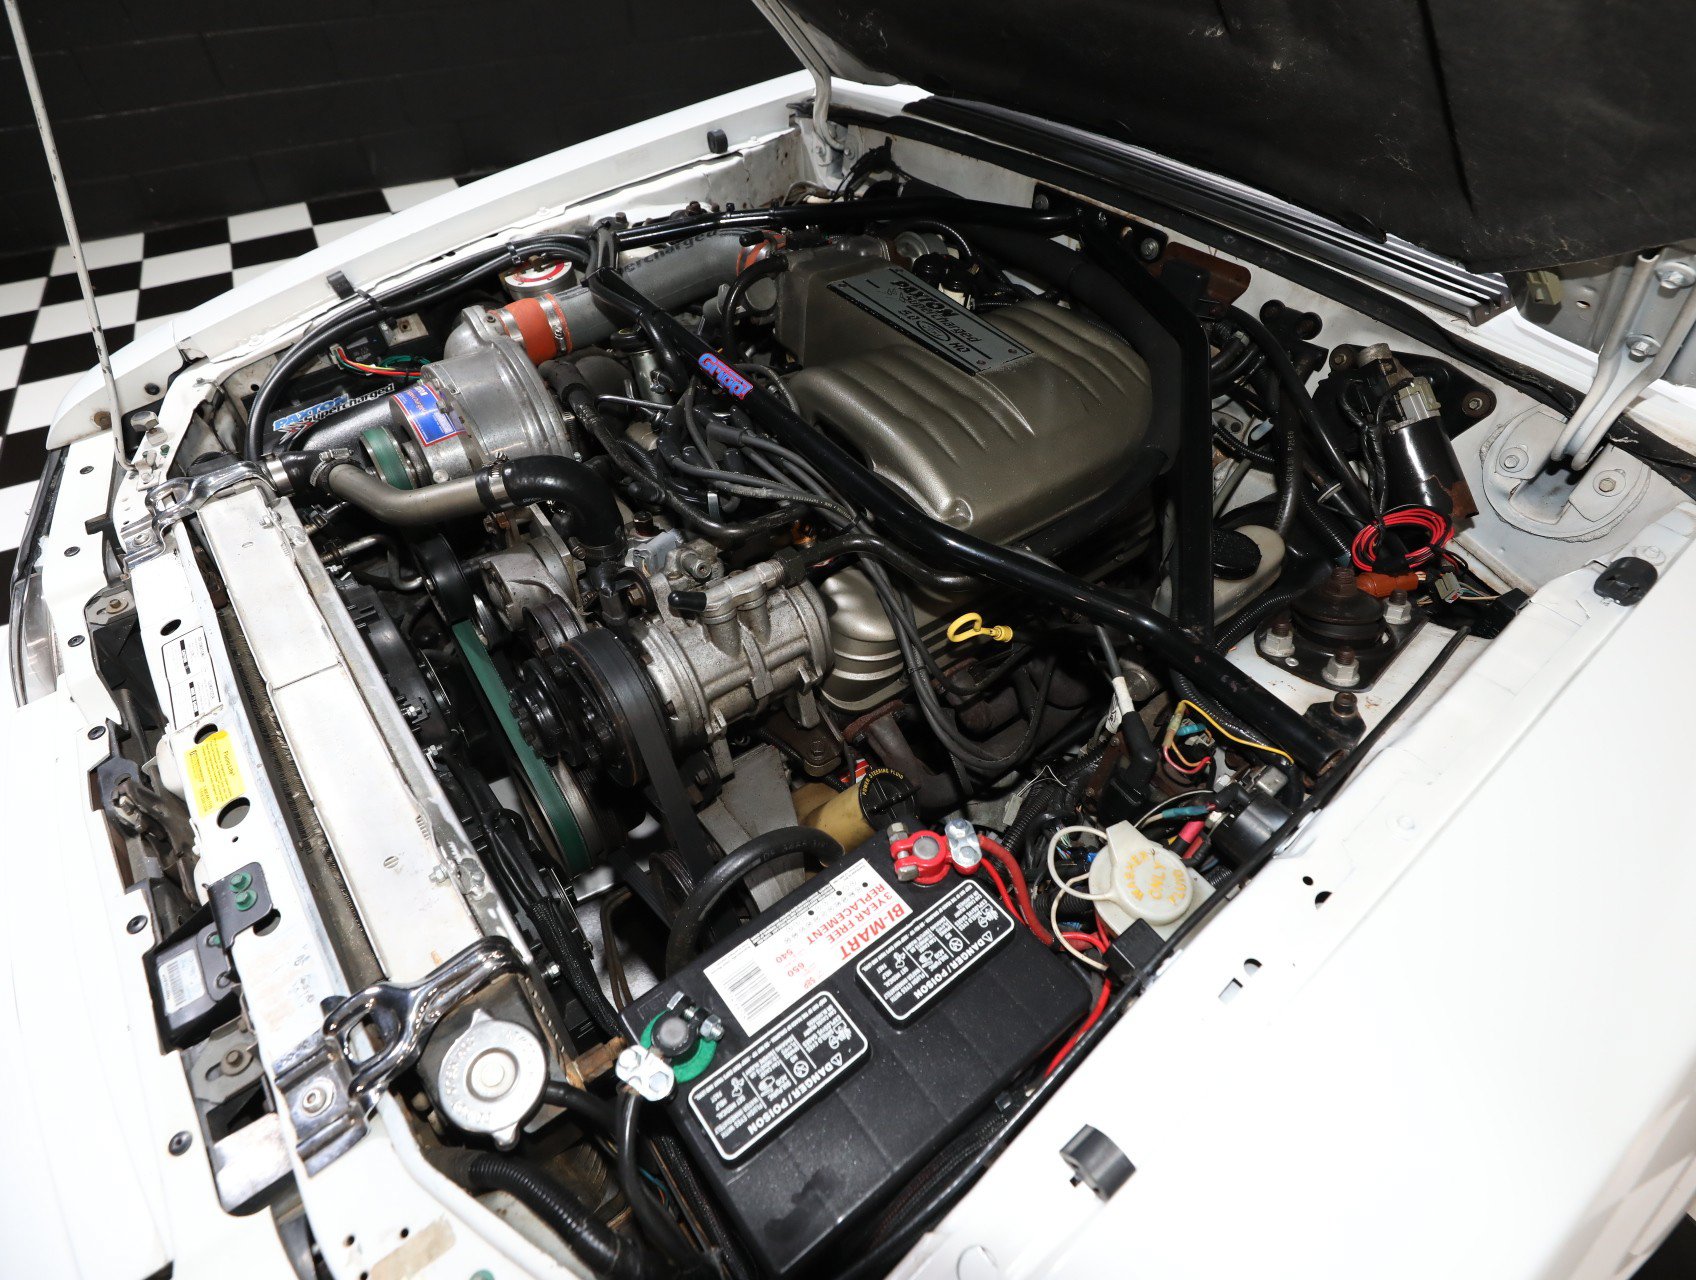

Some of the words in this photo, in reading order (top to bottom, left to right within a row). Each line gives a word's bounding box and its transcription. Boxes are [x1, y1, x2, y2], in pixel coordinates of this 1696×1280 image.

[891, 278, 960, 318] PAXTON
[897, 295, 984, 343] Supercharged
[273, 395, 349, 431] PAXTON
[298, 383, 395, 422] Supercharged
[862, 778, 870, 796] POWER
[869, 768, 889, 778] STEERING
[890, 770, 904, 780] FLUID
[853, 895, 886, 922] YEAR
[882, 891, 893, 900] 3
[803, 882, 885, 945] REPLACEMENT
[825, 919, 855, 944] FREE
[839, 902, 906, 960] BI-MART
[774, 947, 793, 964] 540
[785, 960, 805, 977] 650
